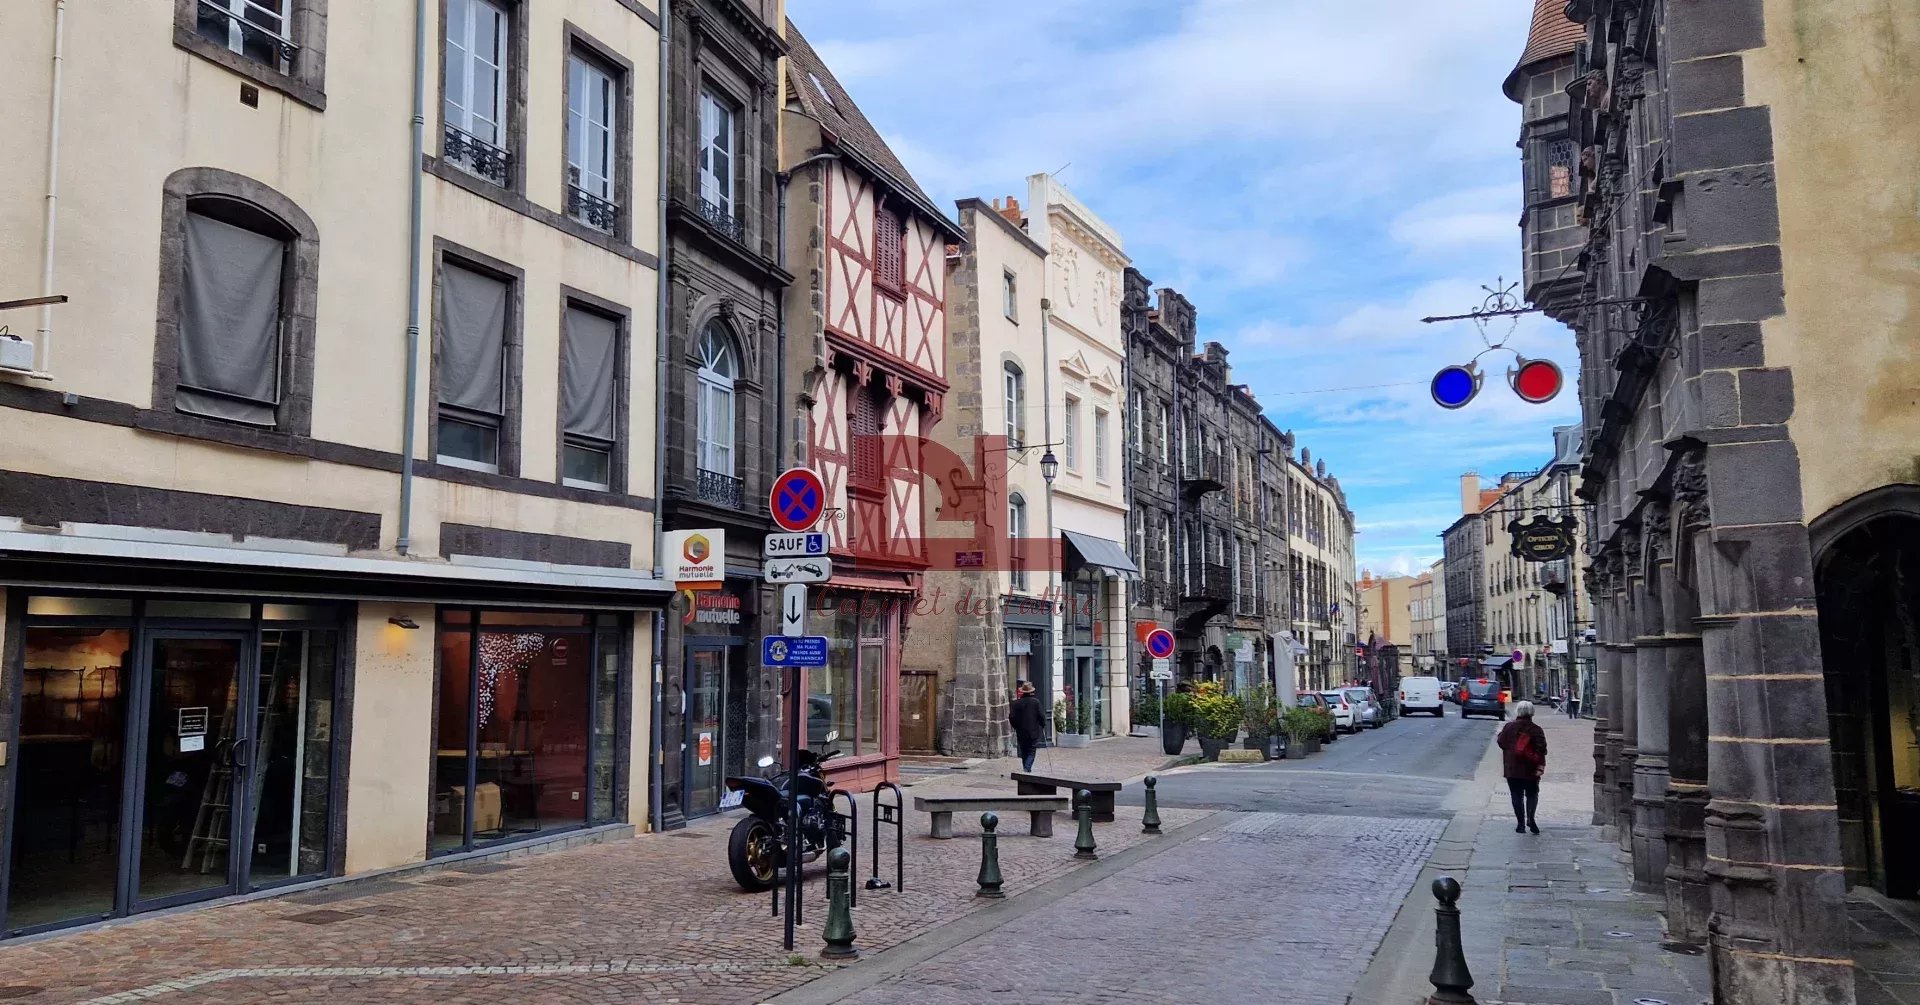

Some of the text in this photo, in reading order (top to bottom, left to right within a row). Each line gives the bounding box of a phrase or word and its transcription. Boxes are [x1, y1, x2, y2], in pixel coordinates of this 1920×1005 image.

[769, 538, 803, 551] SAUF
[696, 591, 740, 609] Harmonie
[696, 608, 740, 624] mutuelle
